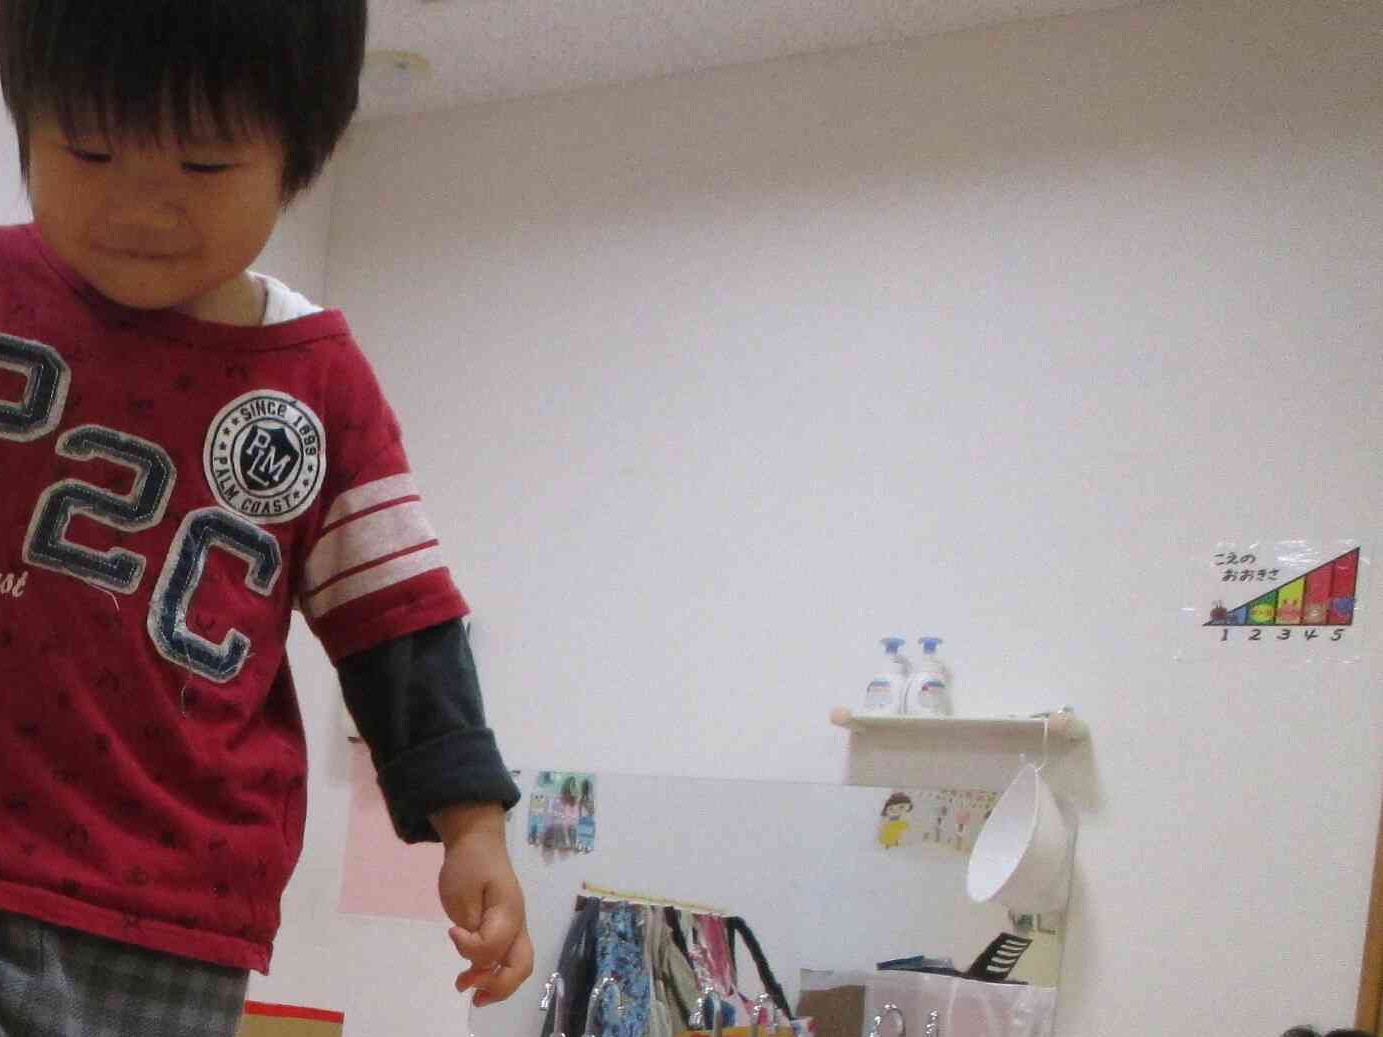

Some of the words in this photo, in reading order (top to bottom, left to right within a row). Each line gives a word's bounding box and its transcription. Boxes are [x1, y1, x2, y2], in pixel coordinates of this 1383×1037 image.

[240, 399, 288, 421] SINCE
[213, 456, 240, 501] PALM
[241, 495, 292, 513] COAST
[1213, 551, 1256, 566] こえの
[1221, 569, 1280, 583] おおきさ
[1220, 628, 1228, 641] 1
[1248, 628, 1262, 641] 2
[1276, 628, 1291, 641] 3
[1304, 628, 1318, 641] 4
[1330, 628, 1346, 641] 5
